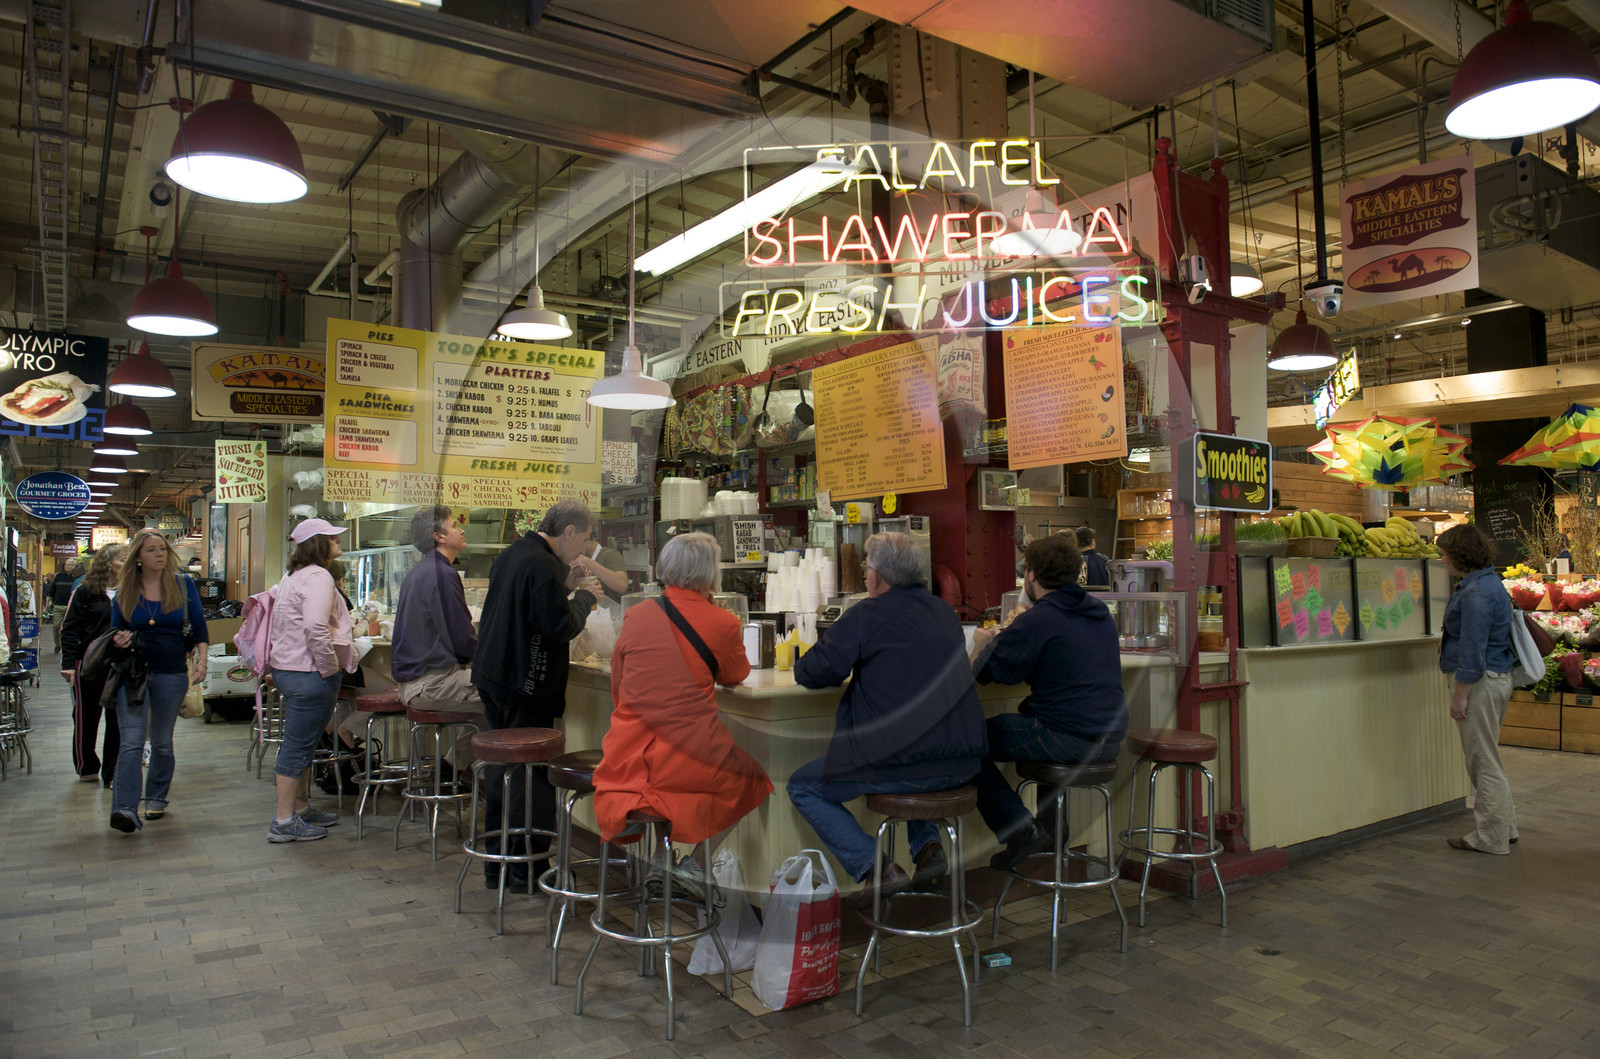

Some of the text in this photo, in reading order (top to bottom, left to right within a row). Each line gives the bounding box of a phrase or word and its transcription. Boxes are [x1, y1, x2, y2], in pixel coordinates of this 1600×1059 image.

[816, 140, 1060, 193] FALAFEL
[1353, 174, 1459, 222] KAMAL'S
[1357, 202, 1458, 234] MIDDLE EASTERN
[1371, 218, 1442, 242] SPECIALTIES
[733, 284, 927, 338] FRESH
[943, 275, 1149, 328] JUICES
[368, 331, 394, 341] PIES
[690, 329, 704, 345] 804
[1024, 330, 1073, 346] FRESH SQUEEZED
[340, 342, 362, 350] SPINACH
[340, 350, 362, 358] SPINACH
[437, 341, 596, 369] TODAY'S SPECIAL
[696, 339, 742, 368] EASTERN
[340, 358, 361, 366] CHICKEN
[370, 362, 394, 370] VEGETABLE
[485, 365, 551, 381] PLATTERS
[959, 375, 971, 383] RICE
[445, 378, 478, 388] MOROCCAN
[480, 381, 504, 391] CHICKEN
[446, 390, 462, 399] SHISH
[465, 392, 485, 401] KABOB
[539, 387, 559, 396] FALAFEL
[237, 394, 315, 405] MIDDLE EASTERN
[365, 392, 391, 402] PITA
[339, 398, 415, 412] SANDWICHES
[446, 403, 470, 412] CHICKEN
[472, 405, 492, 414] KABOB
[538, 399, 558, 408] HUMUS
[246, 404, 308, 414] SPECIALTIES
[446, 415, 479, 425] SHAWERMA
[539, 411, 554, 419] BABA
[339, 418, 358, 426] FALAFEL
[339, 426, 360, 434] CHICKEN
[539, 423, 561, 432] TABOULI
[446, 428, 470, 436] CHICKEN
[472, 430, 504, 439] SHAWERMA
[355, 436, 383, 444] SHAWERMA
[541, 435, 559, 443] GRAPE
[560, 436, 578, 445] LEAVES
[218, 444, 252, 455] FRESH
[602, 450, 632, 458] CHEESE
[471, 459, 570, 475] FRESH JUICES
[611, 459, 635, 467] SALAD
[1197, 440, 1267, 485] Smoothies
[218, 457, 264, 481] SQUEEZED
[624, 467, 638, 475] TEA
[327, 470, 372, 480] SPECIAL
[403, 474, 444, 483] SPECIAL
[22, 481, 85, 491] Jonathan Best
[328, 479, 372, 488] FALAFEL
[404, 482, 444, 490] LAMB
[474, 478, 512, 486] SPECIAL
[218, 483, 266, 499] JUICES
[327, 487, 371, 496] SANDWICH
[403, 490, 444, 498] SHAWERMA
[474, 485, 512, 493] CHICKEN
[403, 497, 444, 505] SANDWICH
[474, 492, 512, 500] SHAWERMA
